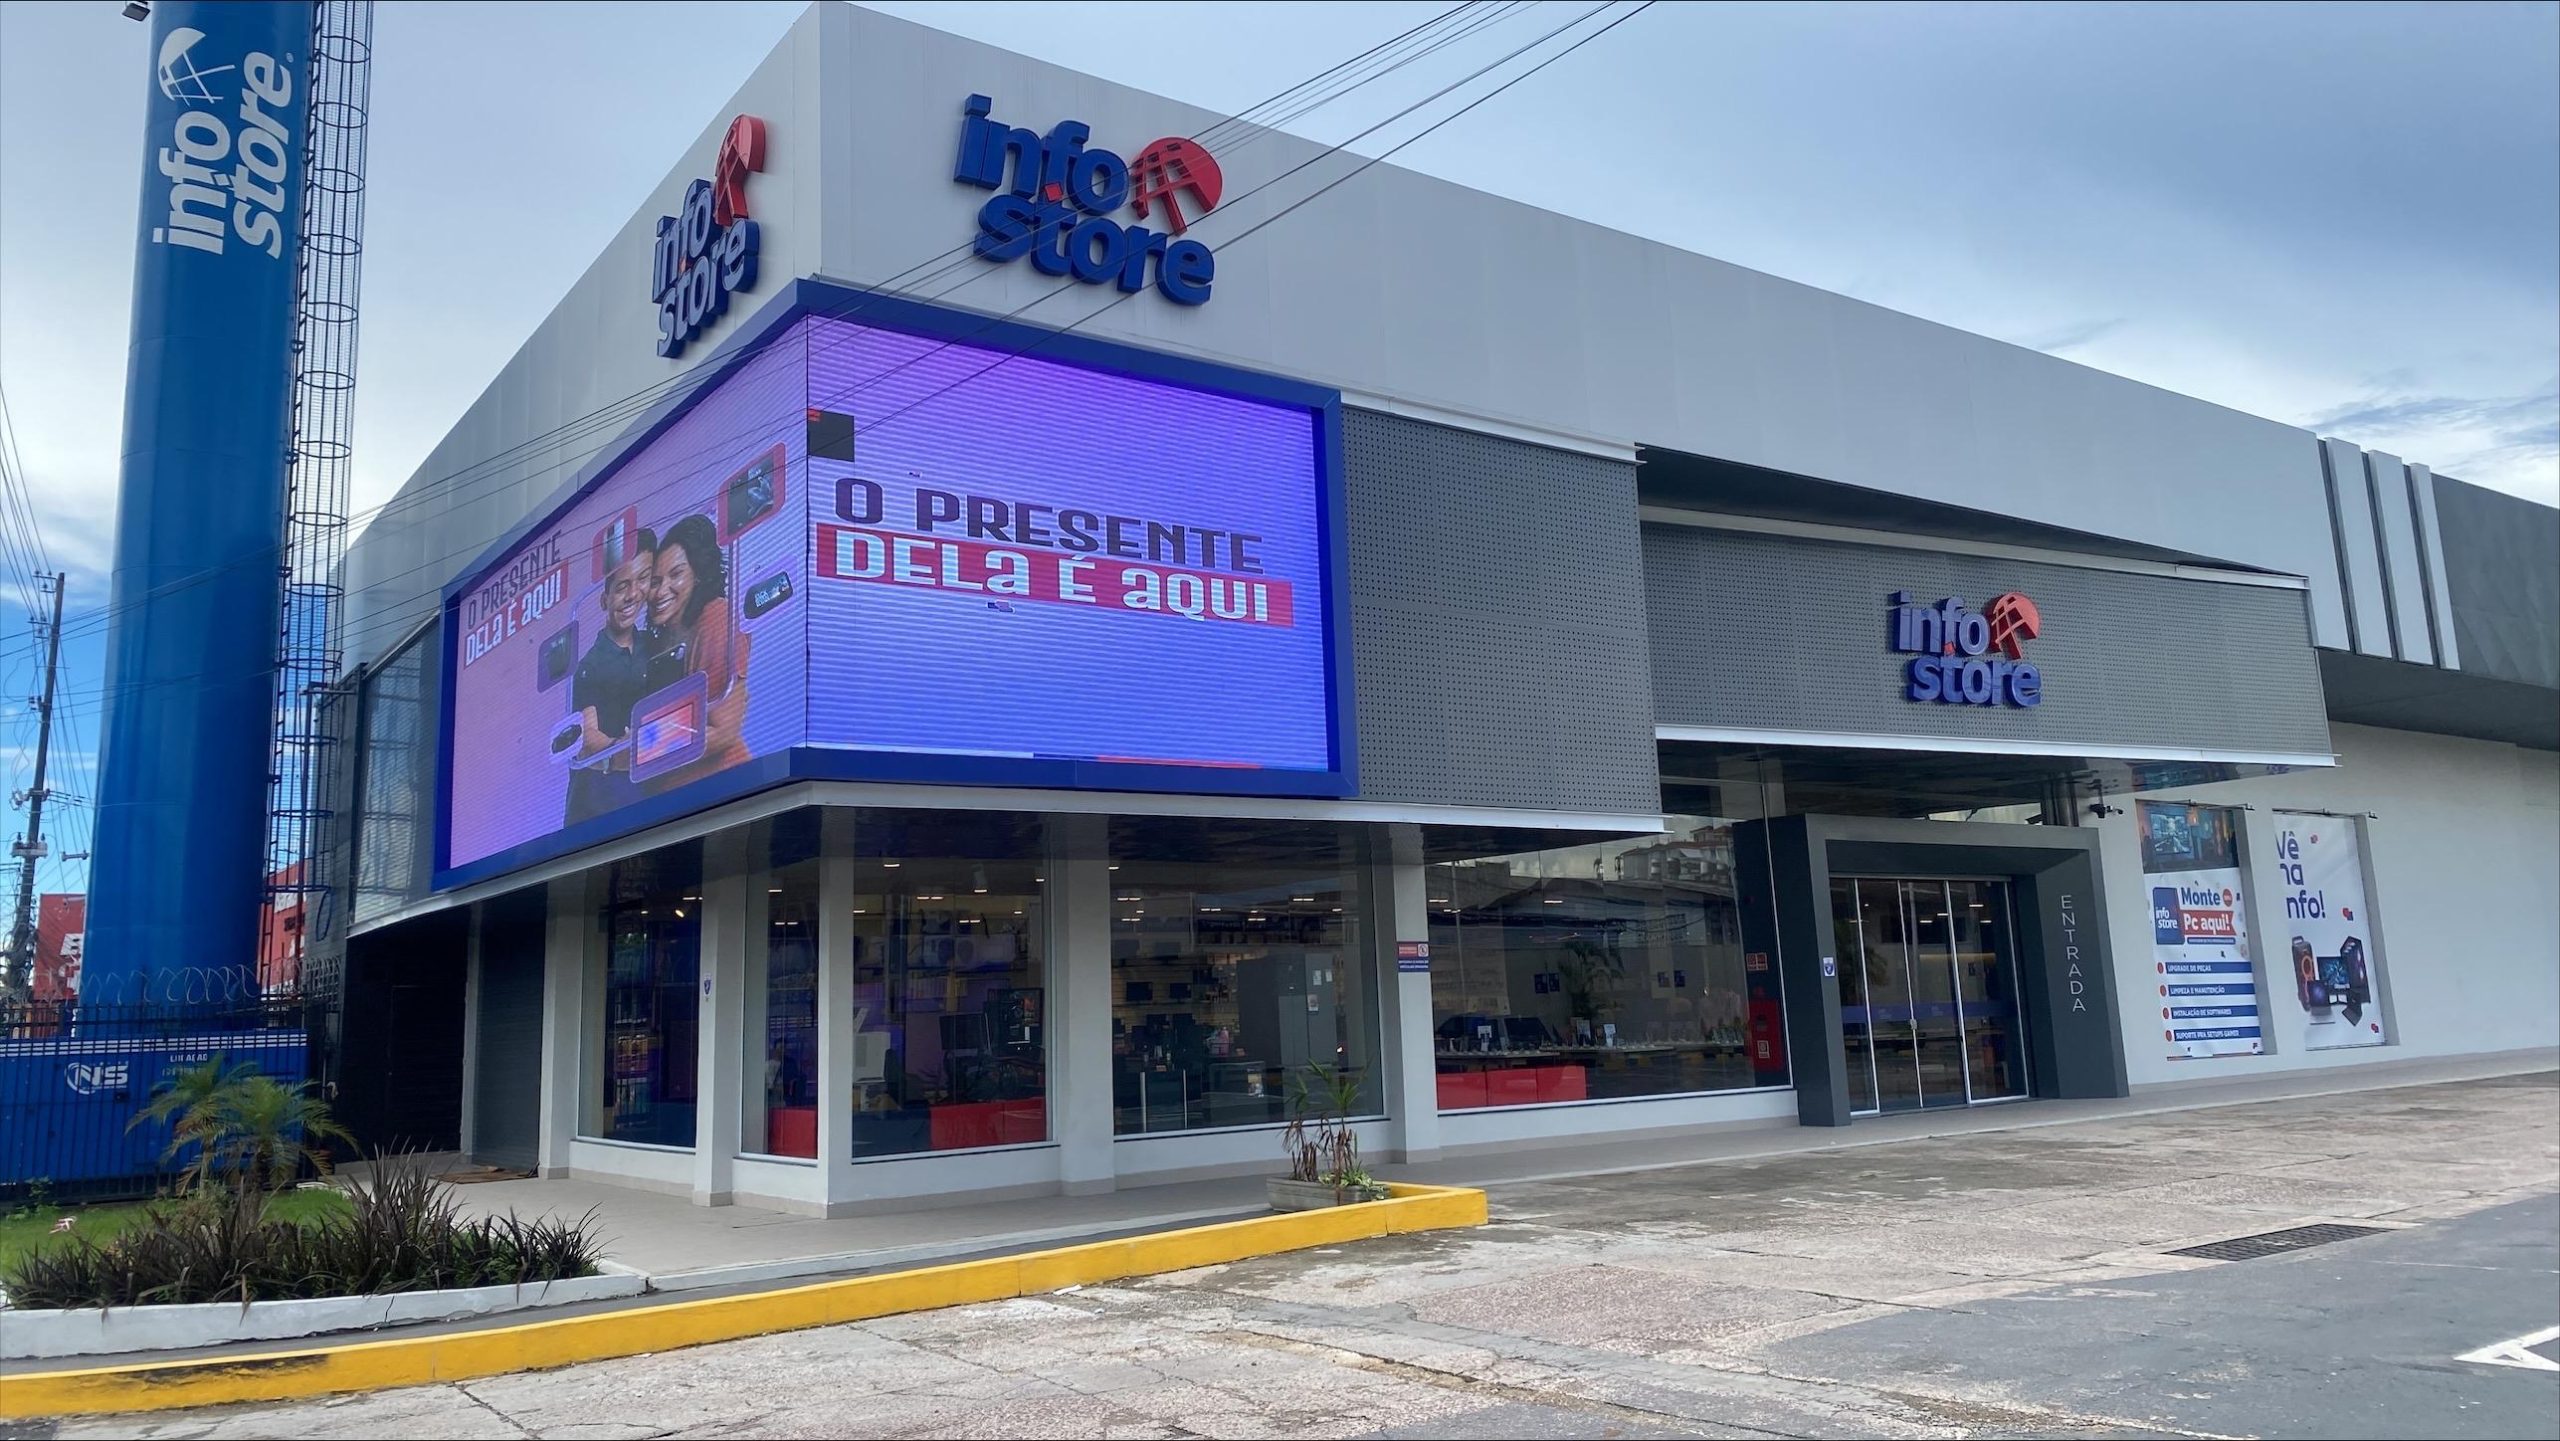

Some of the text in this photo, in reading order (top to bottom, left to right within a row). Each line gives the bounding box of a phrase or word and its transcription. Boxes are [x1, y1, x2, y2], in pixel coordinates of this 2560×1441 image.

[232, 51, 293, 260] store
[954, 93, 1129, 216] info
[153, 111, 231, 255] info
[653, 178, 716, 303] info
[975, 195, 1215, 305] store
[656, 218, 760, 358] store
[834, 477, 1263, 575] O PRESENTE
[467, 530, 561, 630] O PRESENTE
[1058, 552, 1096, 603] É
[506, 598, 518, 637] É
[1889, 590, 1990, 656] info
[1907, 655, 2042, 708] store
[2275, 830, 2299, 860] Vê
[2155, 906, 2170, 919] info
[2181, 887, 2221, 906] Monte
[2286, 889, 2326, 919] nfo!
[2158, 918, 2178, 929] store
[2183, 913, 2231, 935] Pc aqui!
[2060, 894, 2086, 1012] ENTRADA
[2198, 964, 2212, 973] PEÇAS
[2170, 987, 2190, 995] LIMPEZA
[2176, 1031, 2197, 1040] SUPORTE
